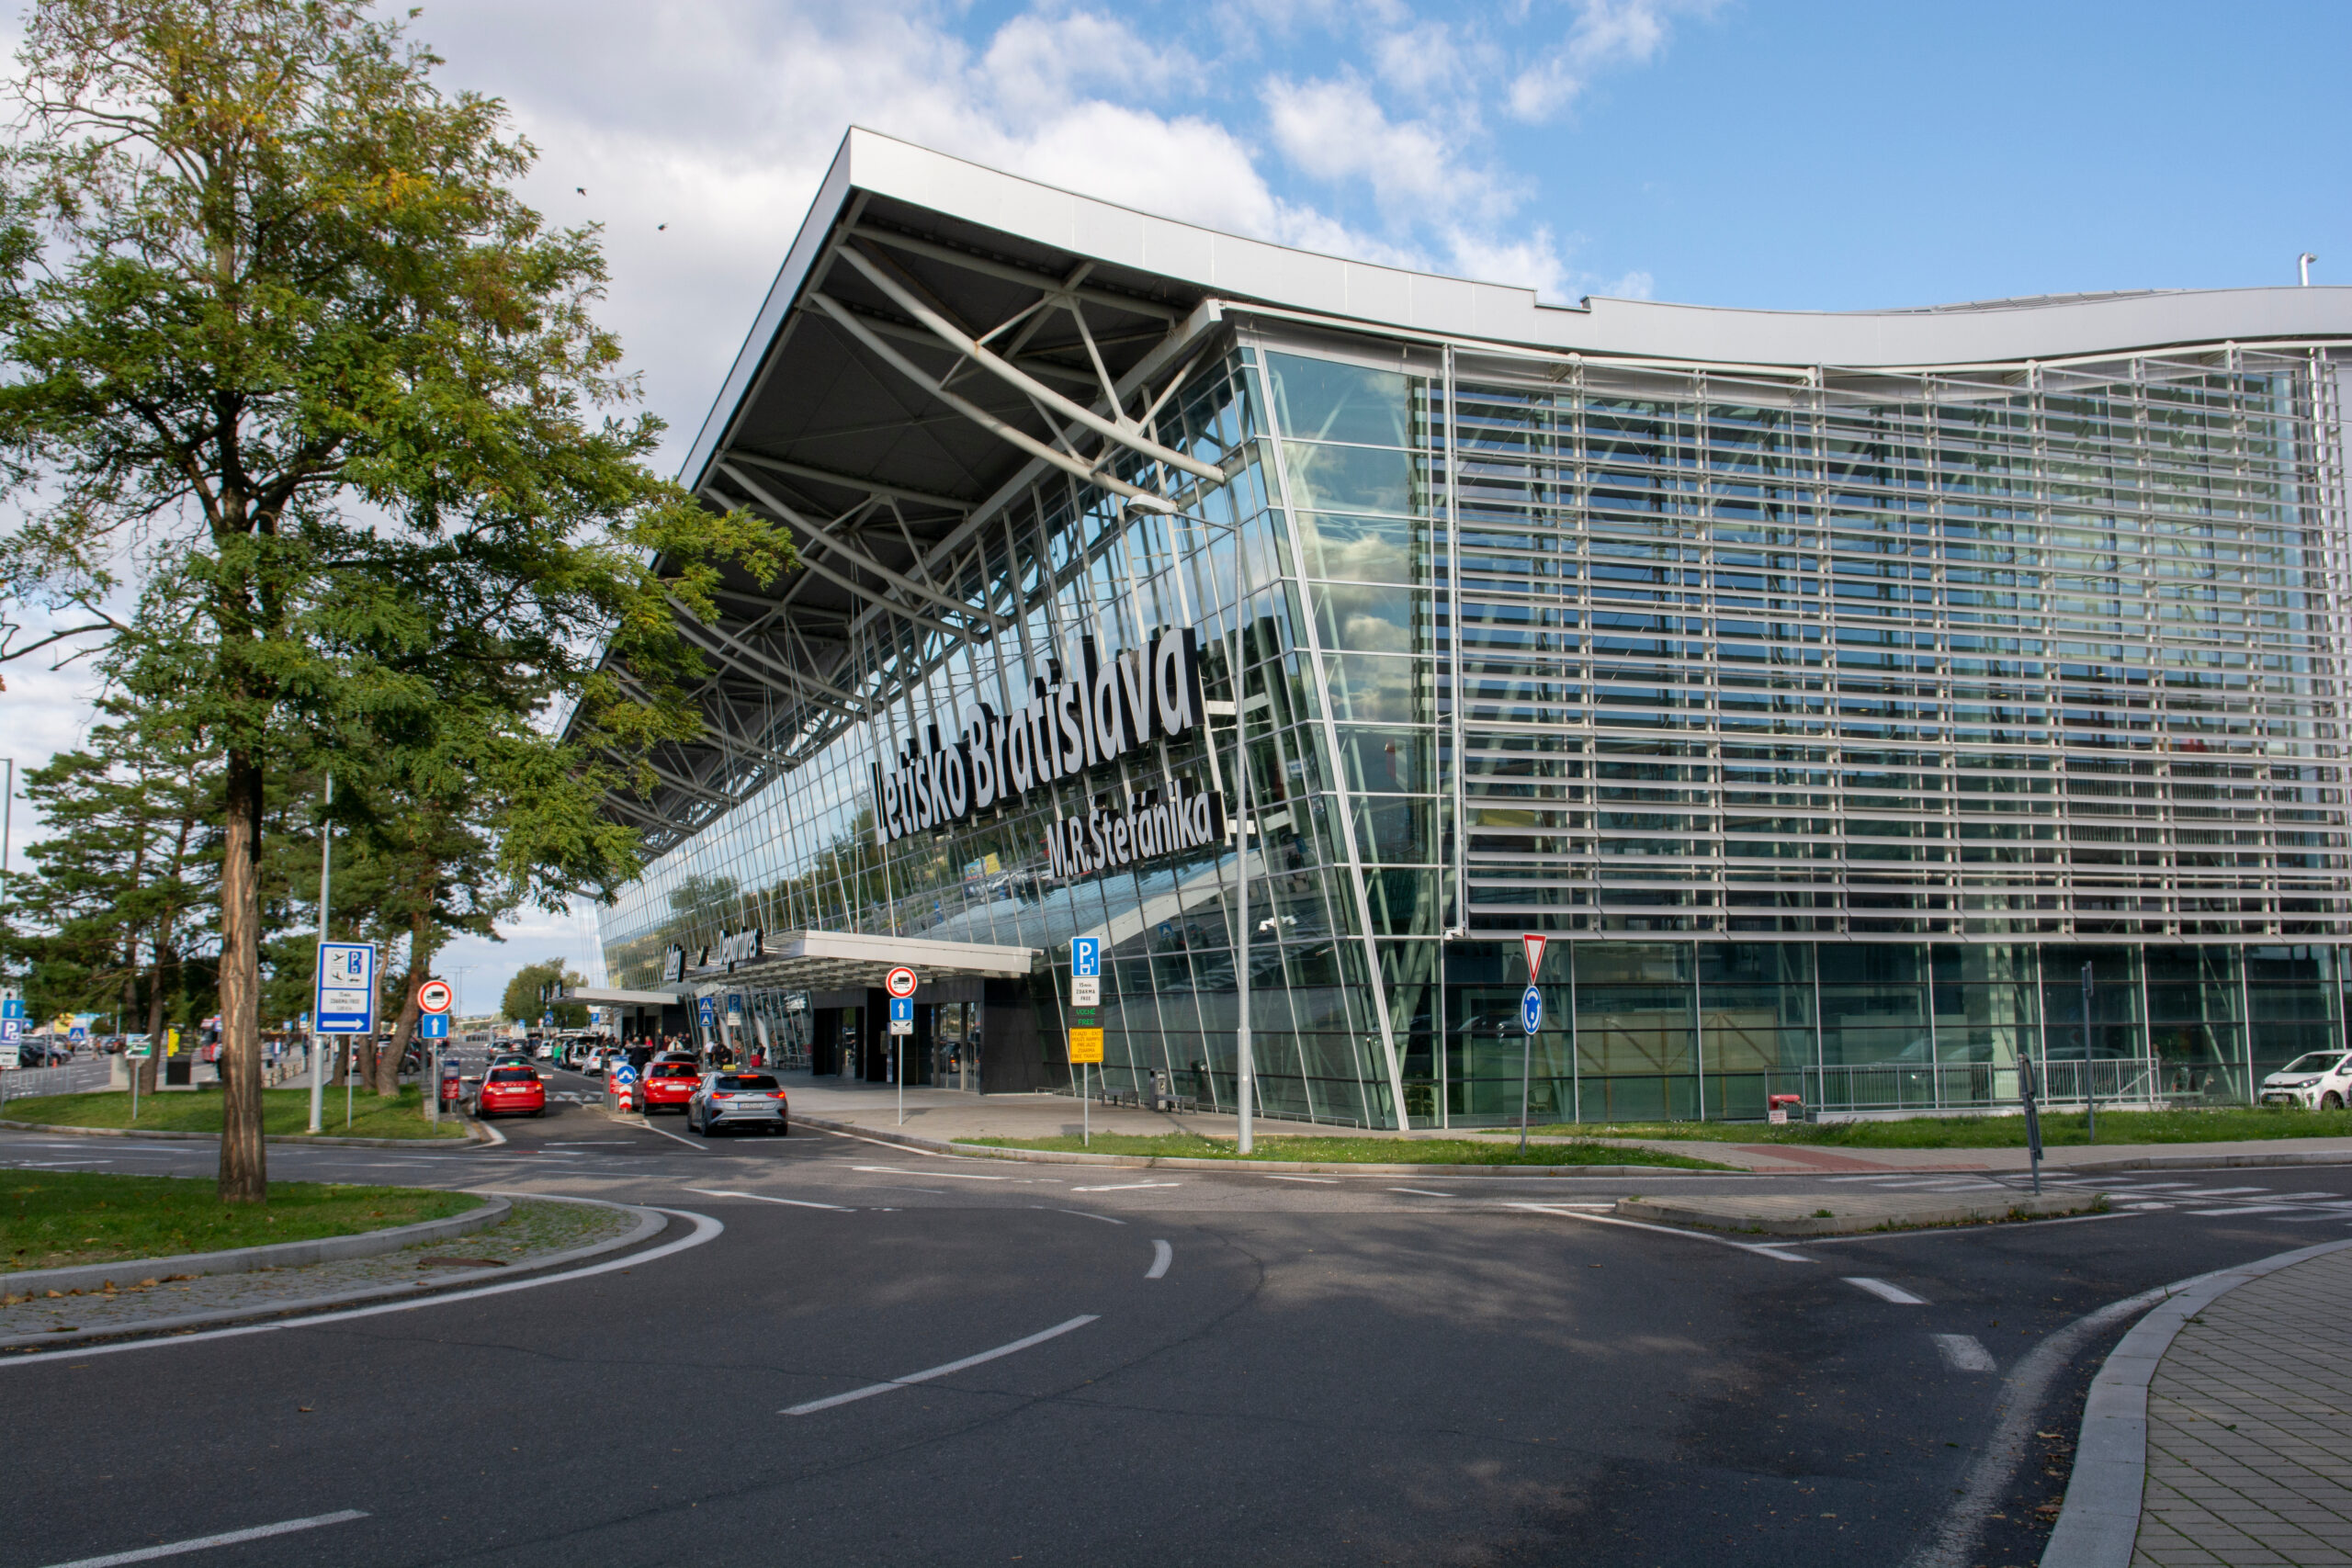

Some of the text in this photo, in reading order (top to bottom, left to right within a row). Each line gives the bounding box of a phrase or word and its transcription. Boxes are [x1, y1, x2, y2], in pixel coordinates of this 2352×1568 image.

[870, 628, 1196, 846] Letisko Bratislava
[1079, 942, 1092, 964] P
